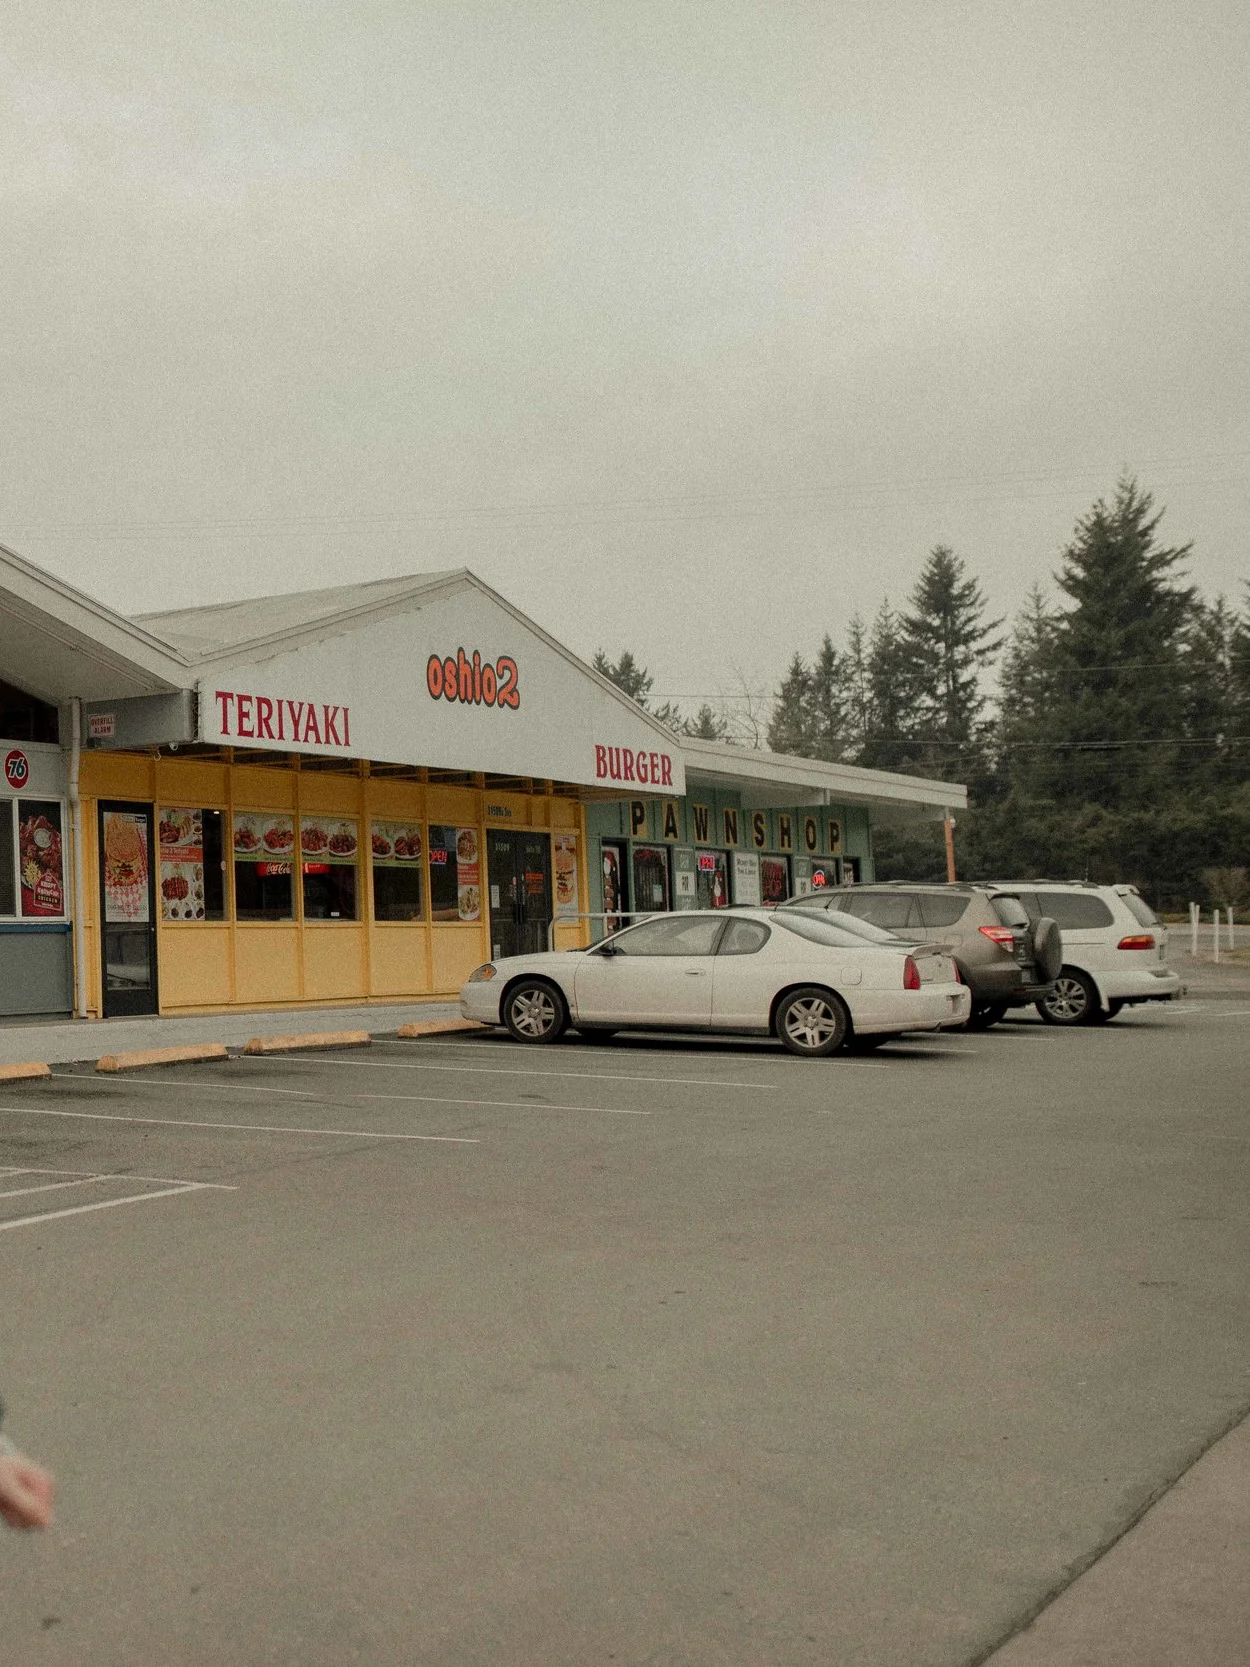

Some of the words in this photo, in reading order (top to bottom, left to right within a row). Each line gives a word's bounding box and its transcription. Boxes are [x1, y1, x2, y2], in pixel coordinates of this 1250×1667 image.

[214, 691, 351, 747] TERIYAKI
[8, 757, 26, 780] 76
[595, 744, 673, 786] BURGER
[40, 880, 57, 889] KRISPY
[37, 894, 59, 903] CHICKEN
